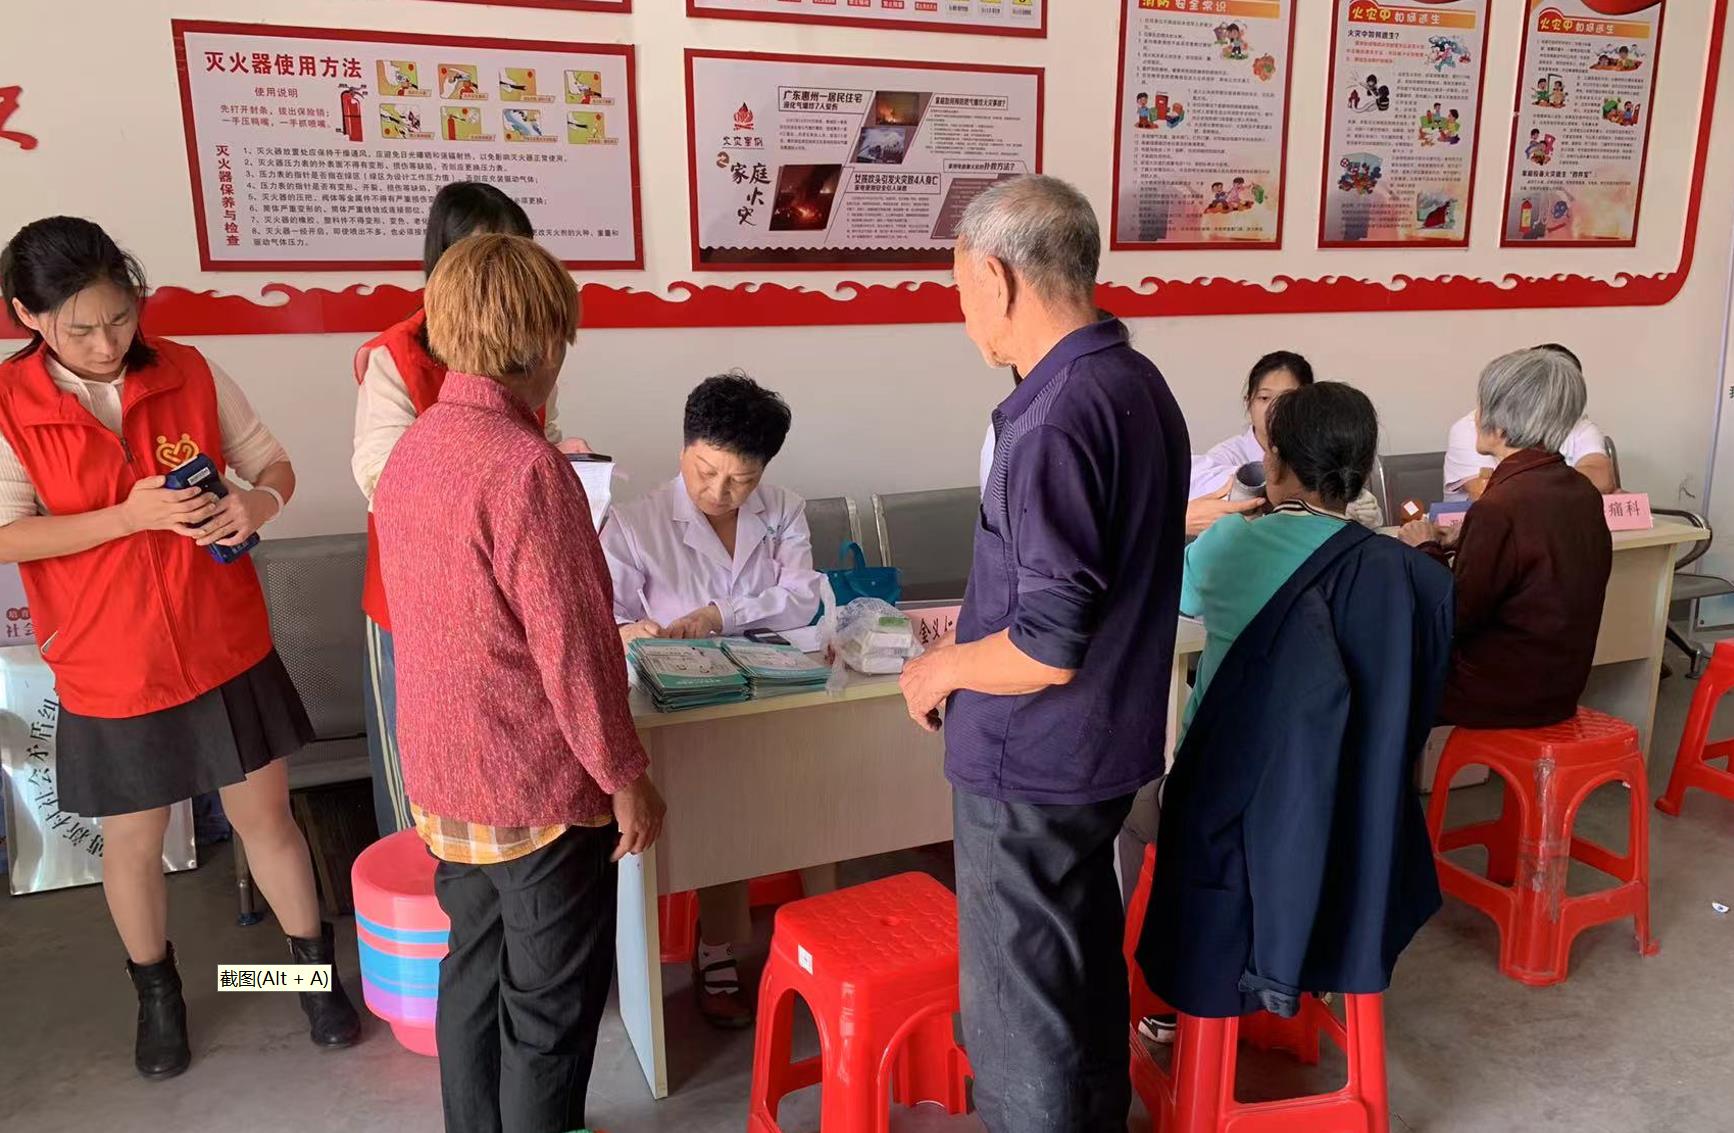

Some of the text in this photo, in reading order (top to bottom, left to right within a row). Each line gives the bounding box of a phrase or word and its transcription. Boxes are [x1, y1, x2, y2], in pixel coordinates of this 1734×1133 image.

[204, 51, 363, 79] 灭火器使用方法
[254, 86, 299, 99] 使用说明
[783, 90, 863, 103] 广东惠州一居民住宅
[215, 144, 240, 247] 灭火器保养与检查
[1608, 500, 1641, 517] 痛科
